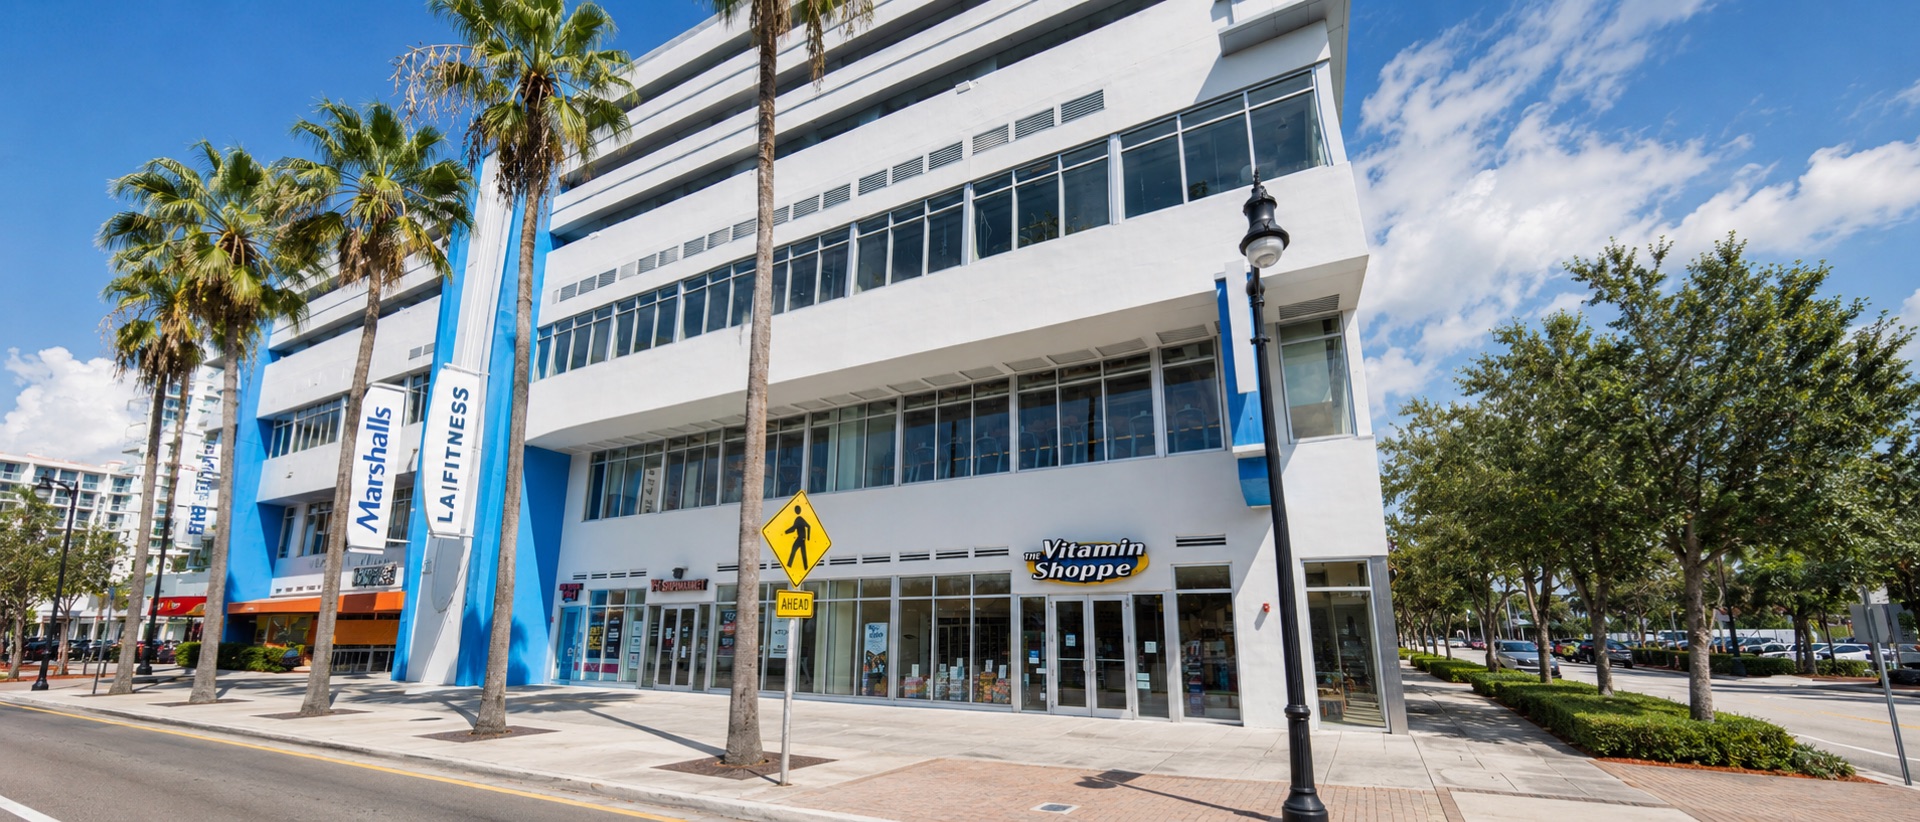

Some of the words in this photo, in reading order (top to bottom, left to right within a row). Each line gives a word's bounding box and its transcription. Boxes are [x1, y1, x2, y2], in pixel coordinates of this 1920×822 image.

[356, 406, 392, 534] Marshalls
[1024, 552, 1042, 561] THE
[1043, 538, 1145, 560] Vitamin
[1032, 562, 1131, 582] Shoppe
[781, 598, 809, 610] AHEAD
